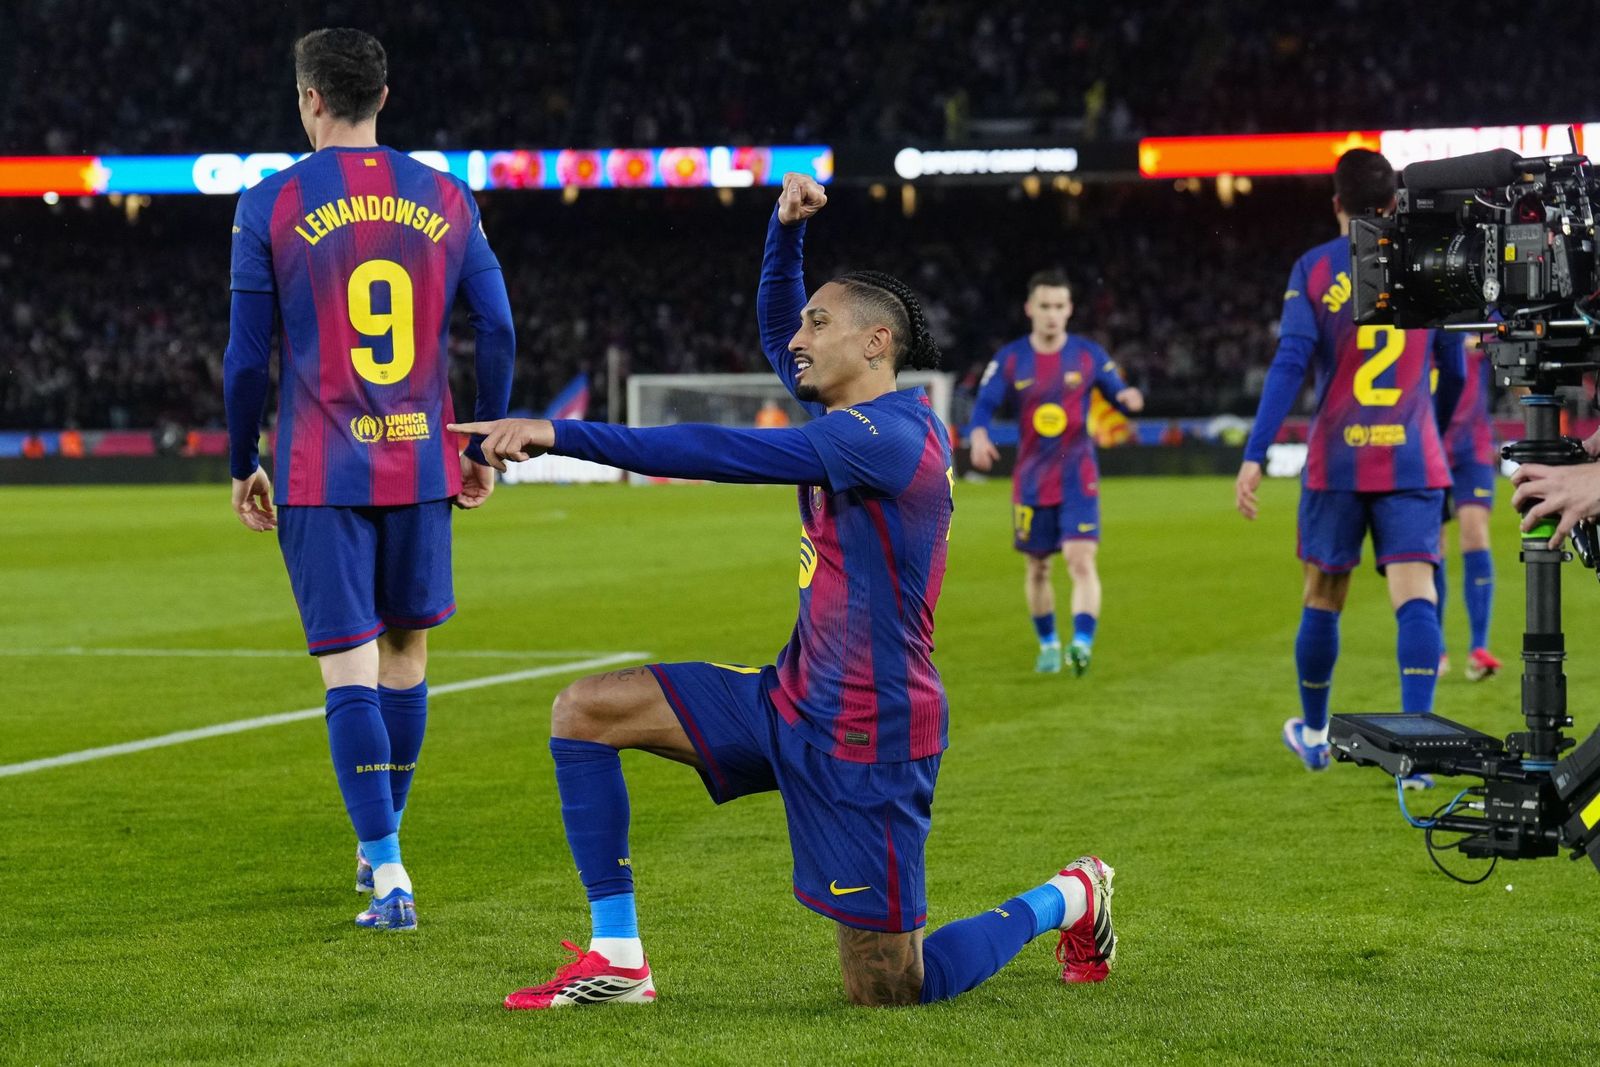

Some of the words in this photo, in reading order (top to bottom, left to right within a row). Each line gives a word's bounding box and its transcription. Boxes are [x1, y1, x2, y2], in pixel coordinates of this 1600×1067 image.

[294, 195, 451, 246] LEWANDOWSKI
[347, 259, 415, 385] 9
[1353, 324, 1406, 406] 2
[385, 412, 427, 426] UNHCR
[386, 424, 429, 437] ACNUR
